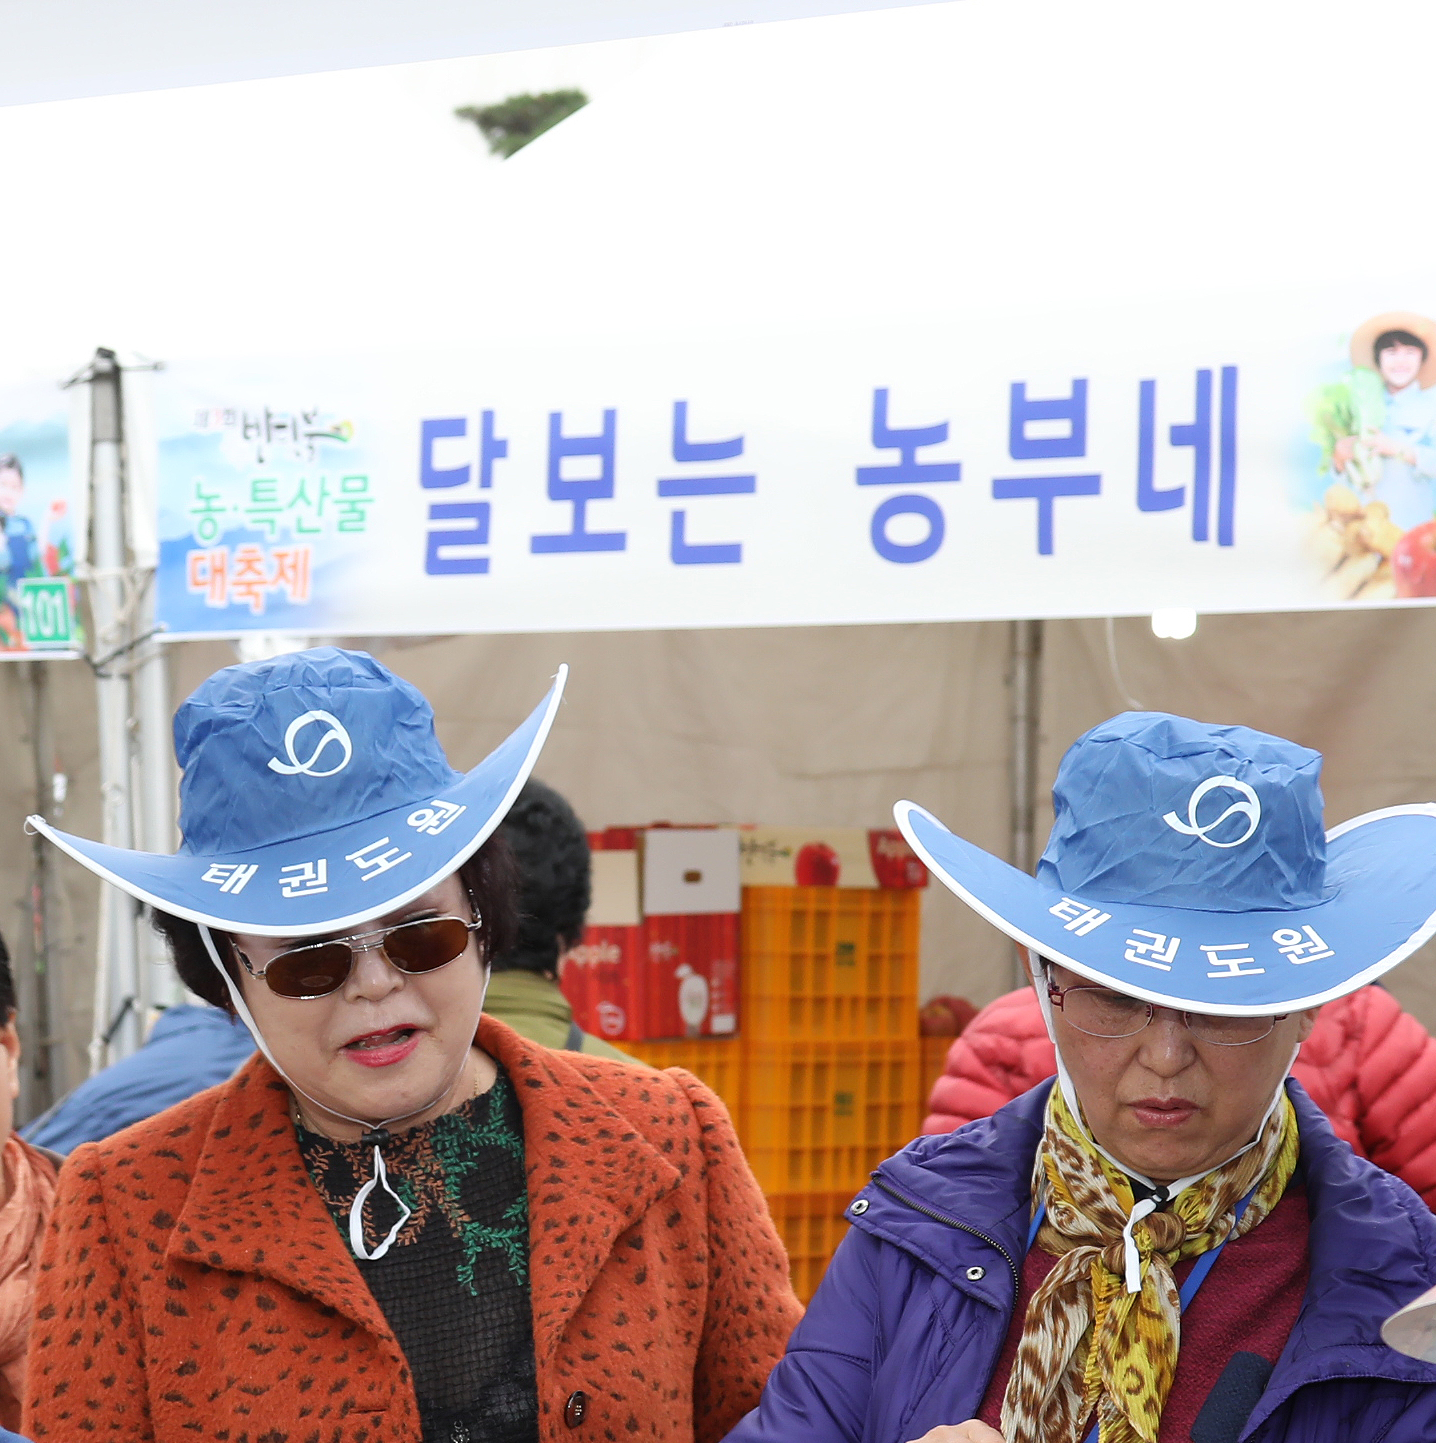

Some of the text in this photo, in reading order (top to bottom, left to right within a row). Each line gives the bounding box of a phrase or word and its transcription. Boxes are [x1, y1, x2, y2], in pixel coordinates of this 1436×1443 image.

[420, 365, 1239, 576] 달보는 농부네
[22, 590, 67, 636] 101
[191, 548, 311, 610] 대축제
[200, 798, 468, 899] 태권도원
[1048, 896, 1336, 980] 태권도원
